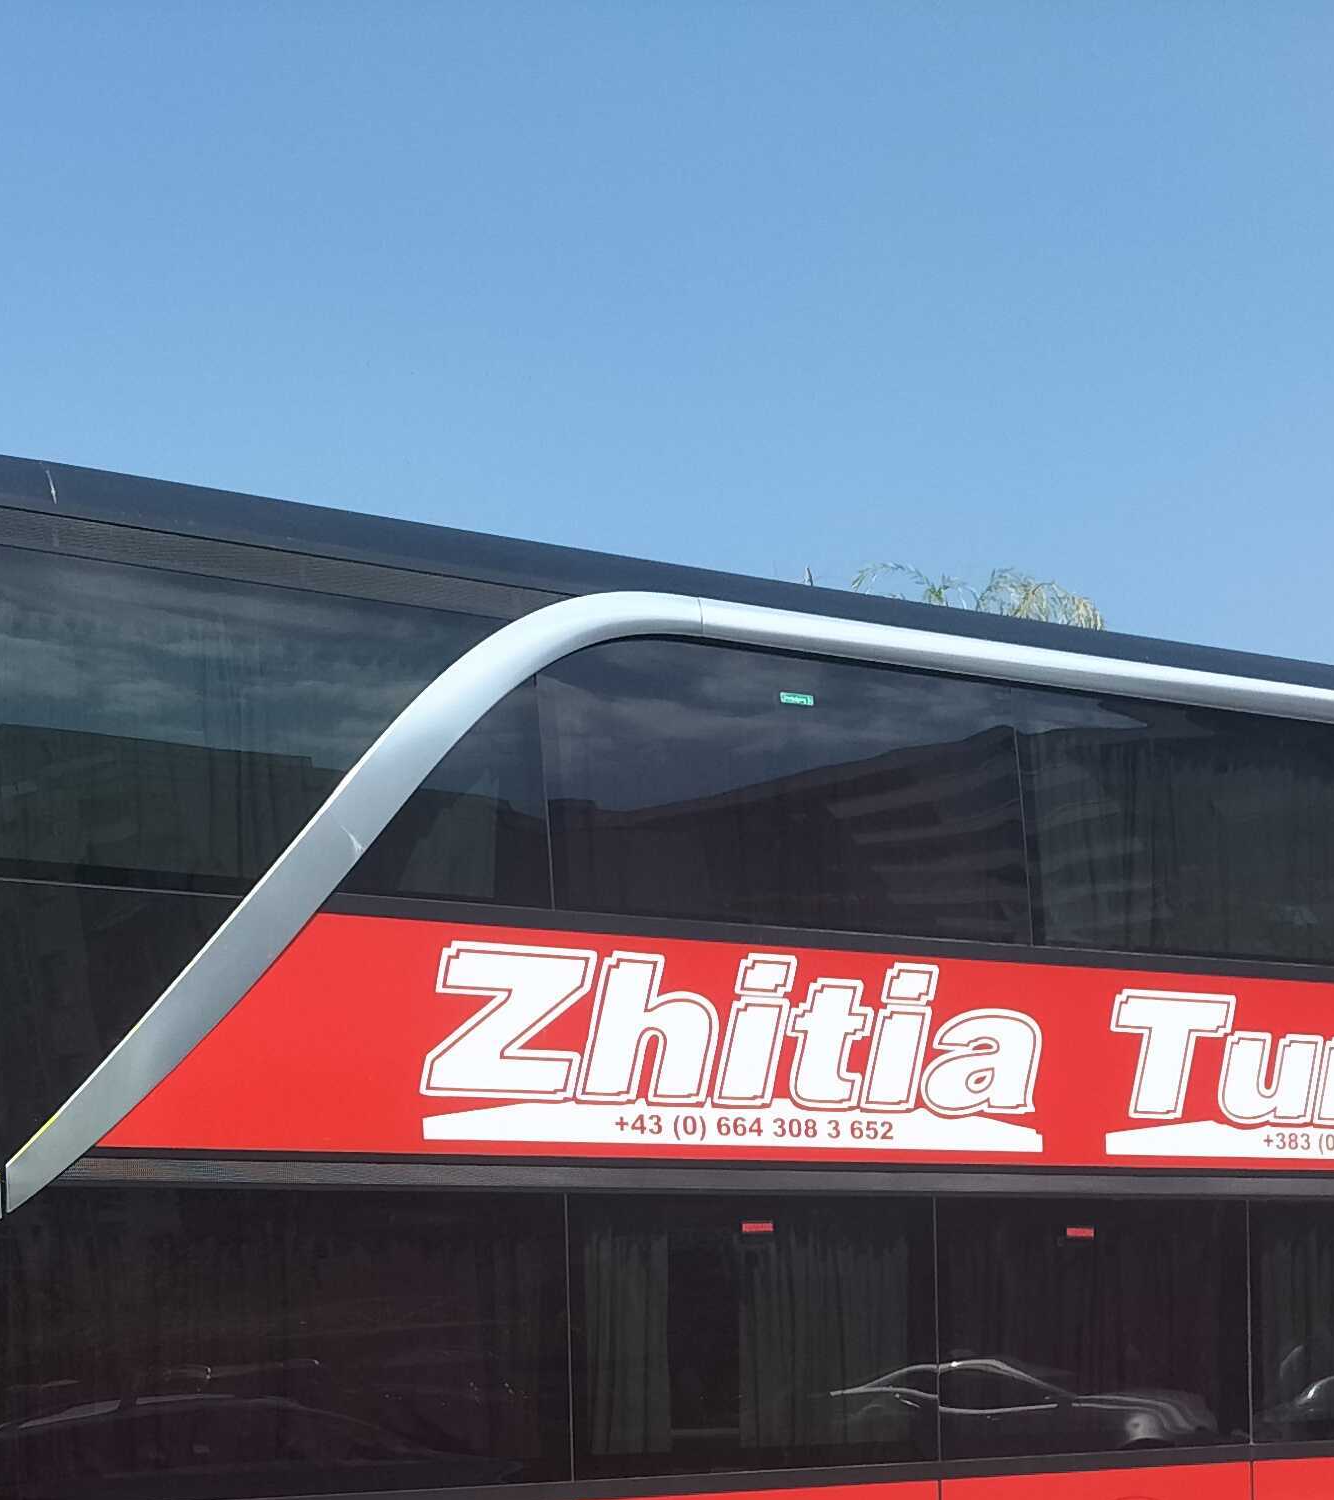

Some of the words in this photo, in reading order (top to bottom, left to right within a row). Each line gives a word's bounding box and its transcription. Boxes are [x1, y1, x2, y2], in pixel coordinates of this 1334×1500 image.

[419, 940, 1043, 1117] Zhitia
[615, 1114, 663, 1136] +43
[673, 1114, 707, 1141] (0)
[716, 1116, 764, 1137] 664
[772, 1117, 818, 1138] 308
[827, 1119, 841, 1139] 3
[850, 1120, 894, 1140] 652
[1263, 1132, 1311, 1150] +383
